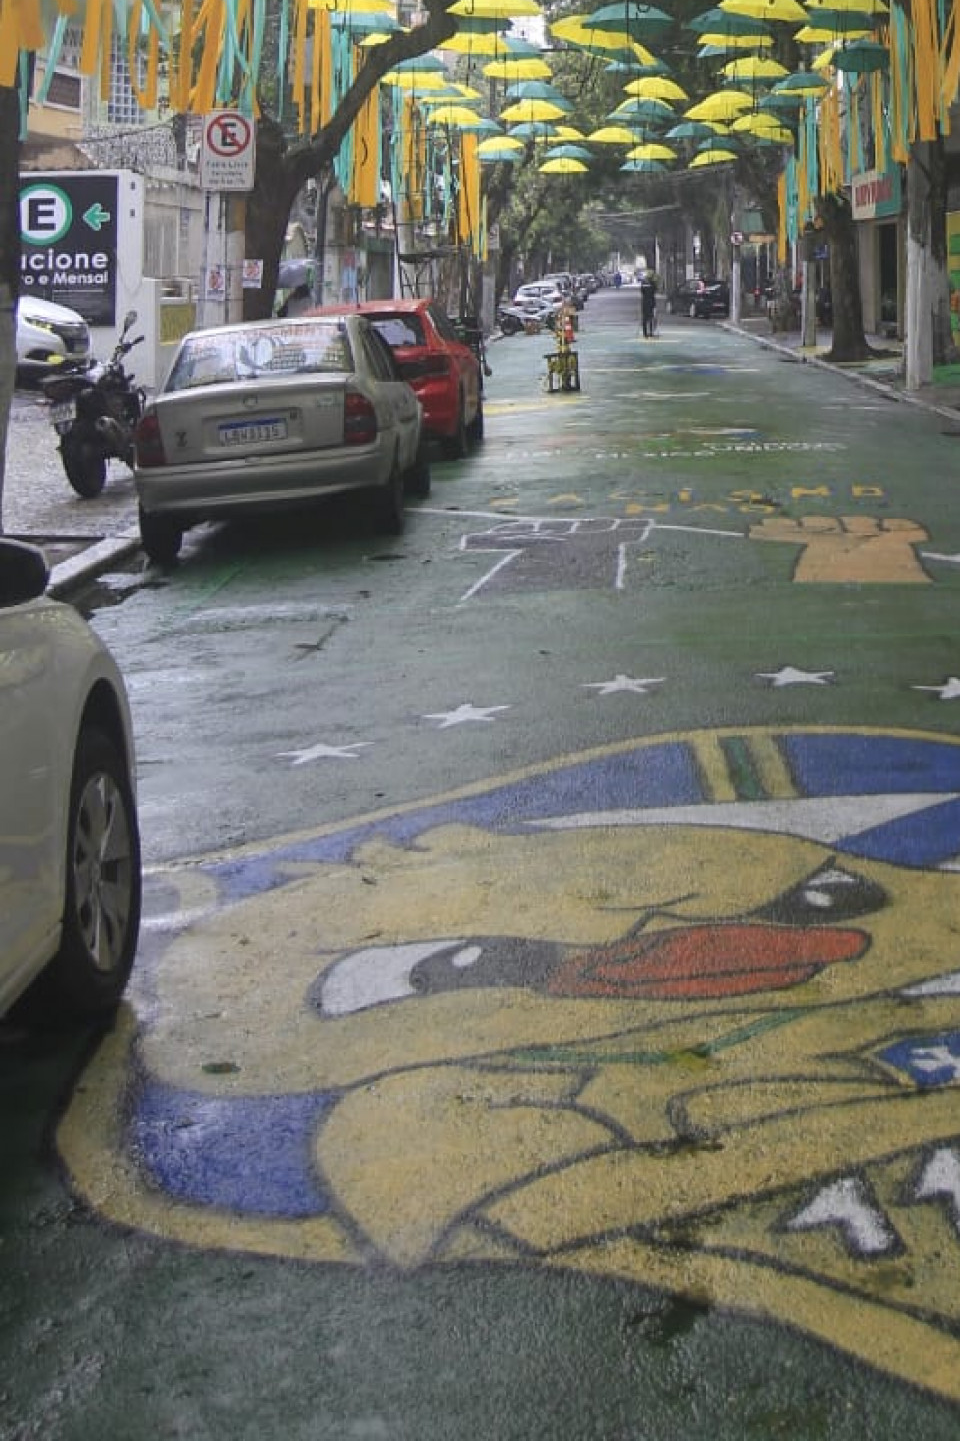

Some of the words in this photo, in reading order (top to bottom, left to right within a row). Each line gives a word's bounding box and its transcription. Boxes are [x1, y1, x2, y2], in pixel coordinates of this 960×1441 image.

[28, 198, 57, 231] E
[38, 275, 49, 285] e
[53, 270, 109, 285] Mensal
